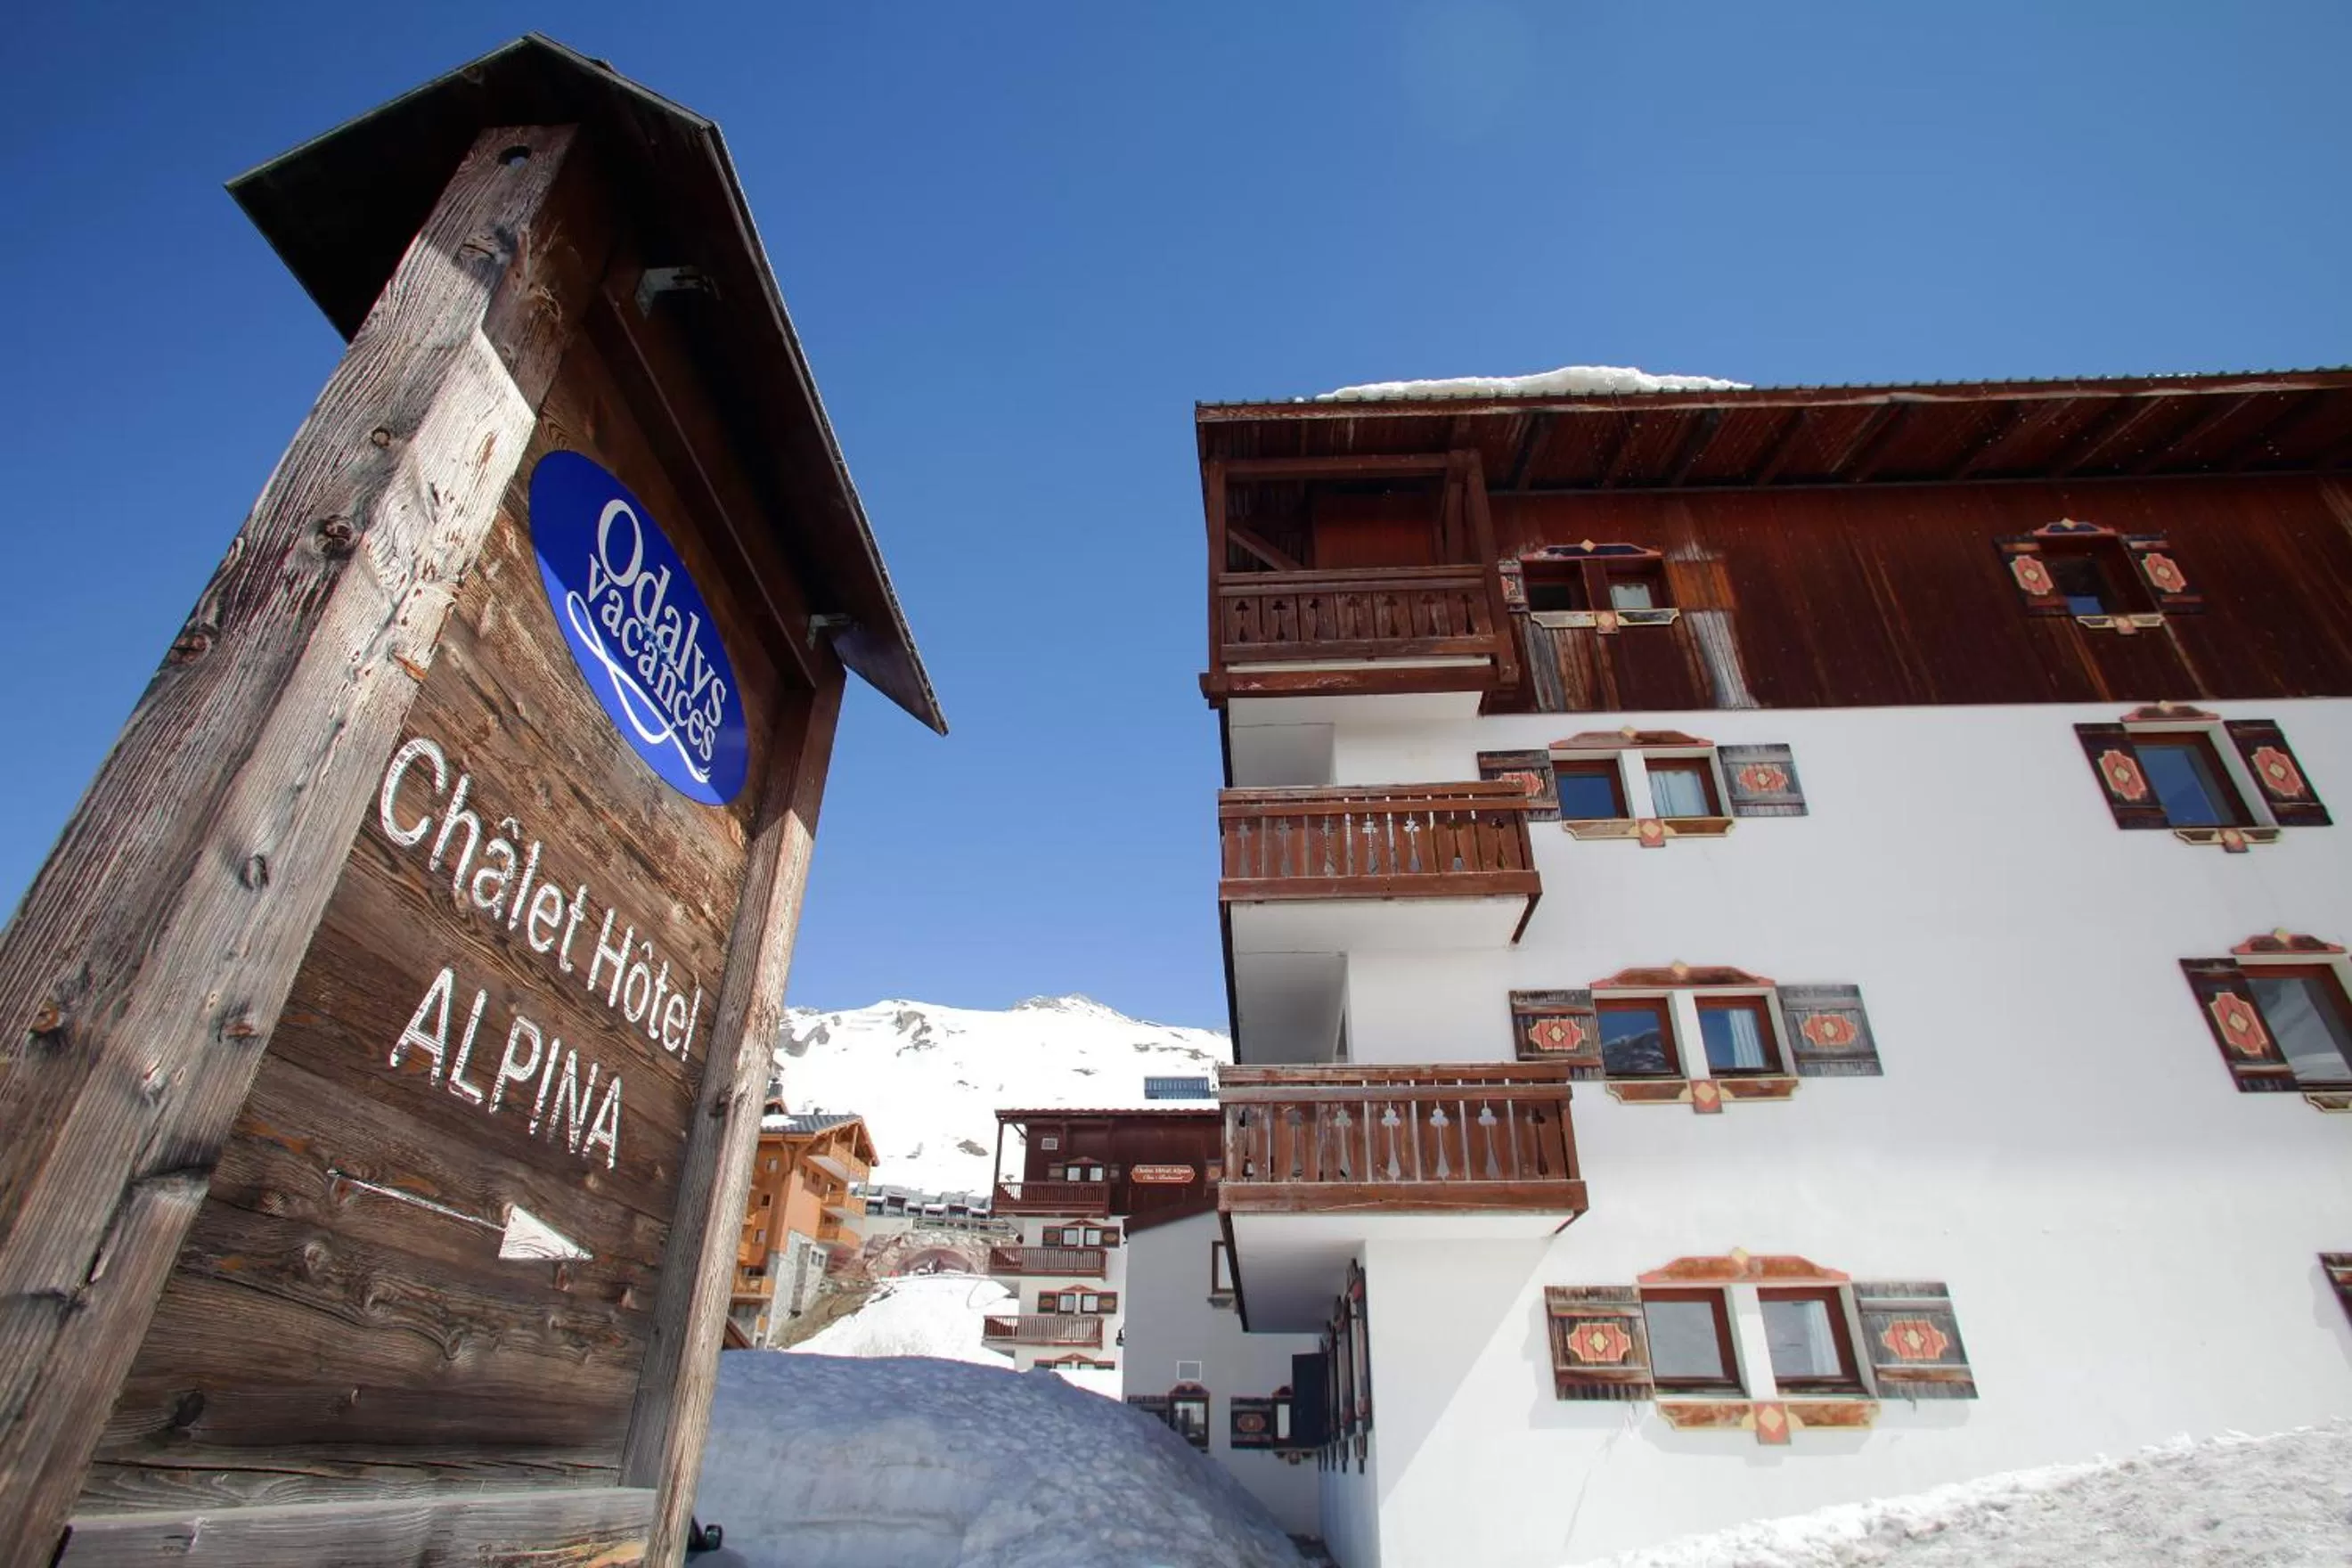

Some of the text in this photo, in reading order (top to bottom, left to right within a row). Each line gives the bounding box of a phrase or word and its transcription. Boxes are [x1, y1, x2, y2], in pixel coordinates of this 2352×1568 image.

[589, 553, 715, 763] vacances
[598, 499, 726, 727] Odalys
[380, 737, 702, 1063] Châlet Hôtel
[389, 967, 621, 1170] ALPINA
